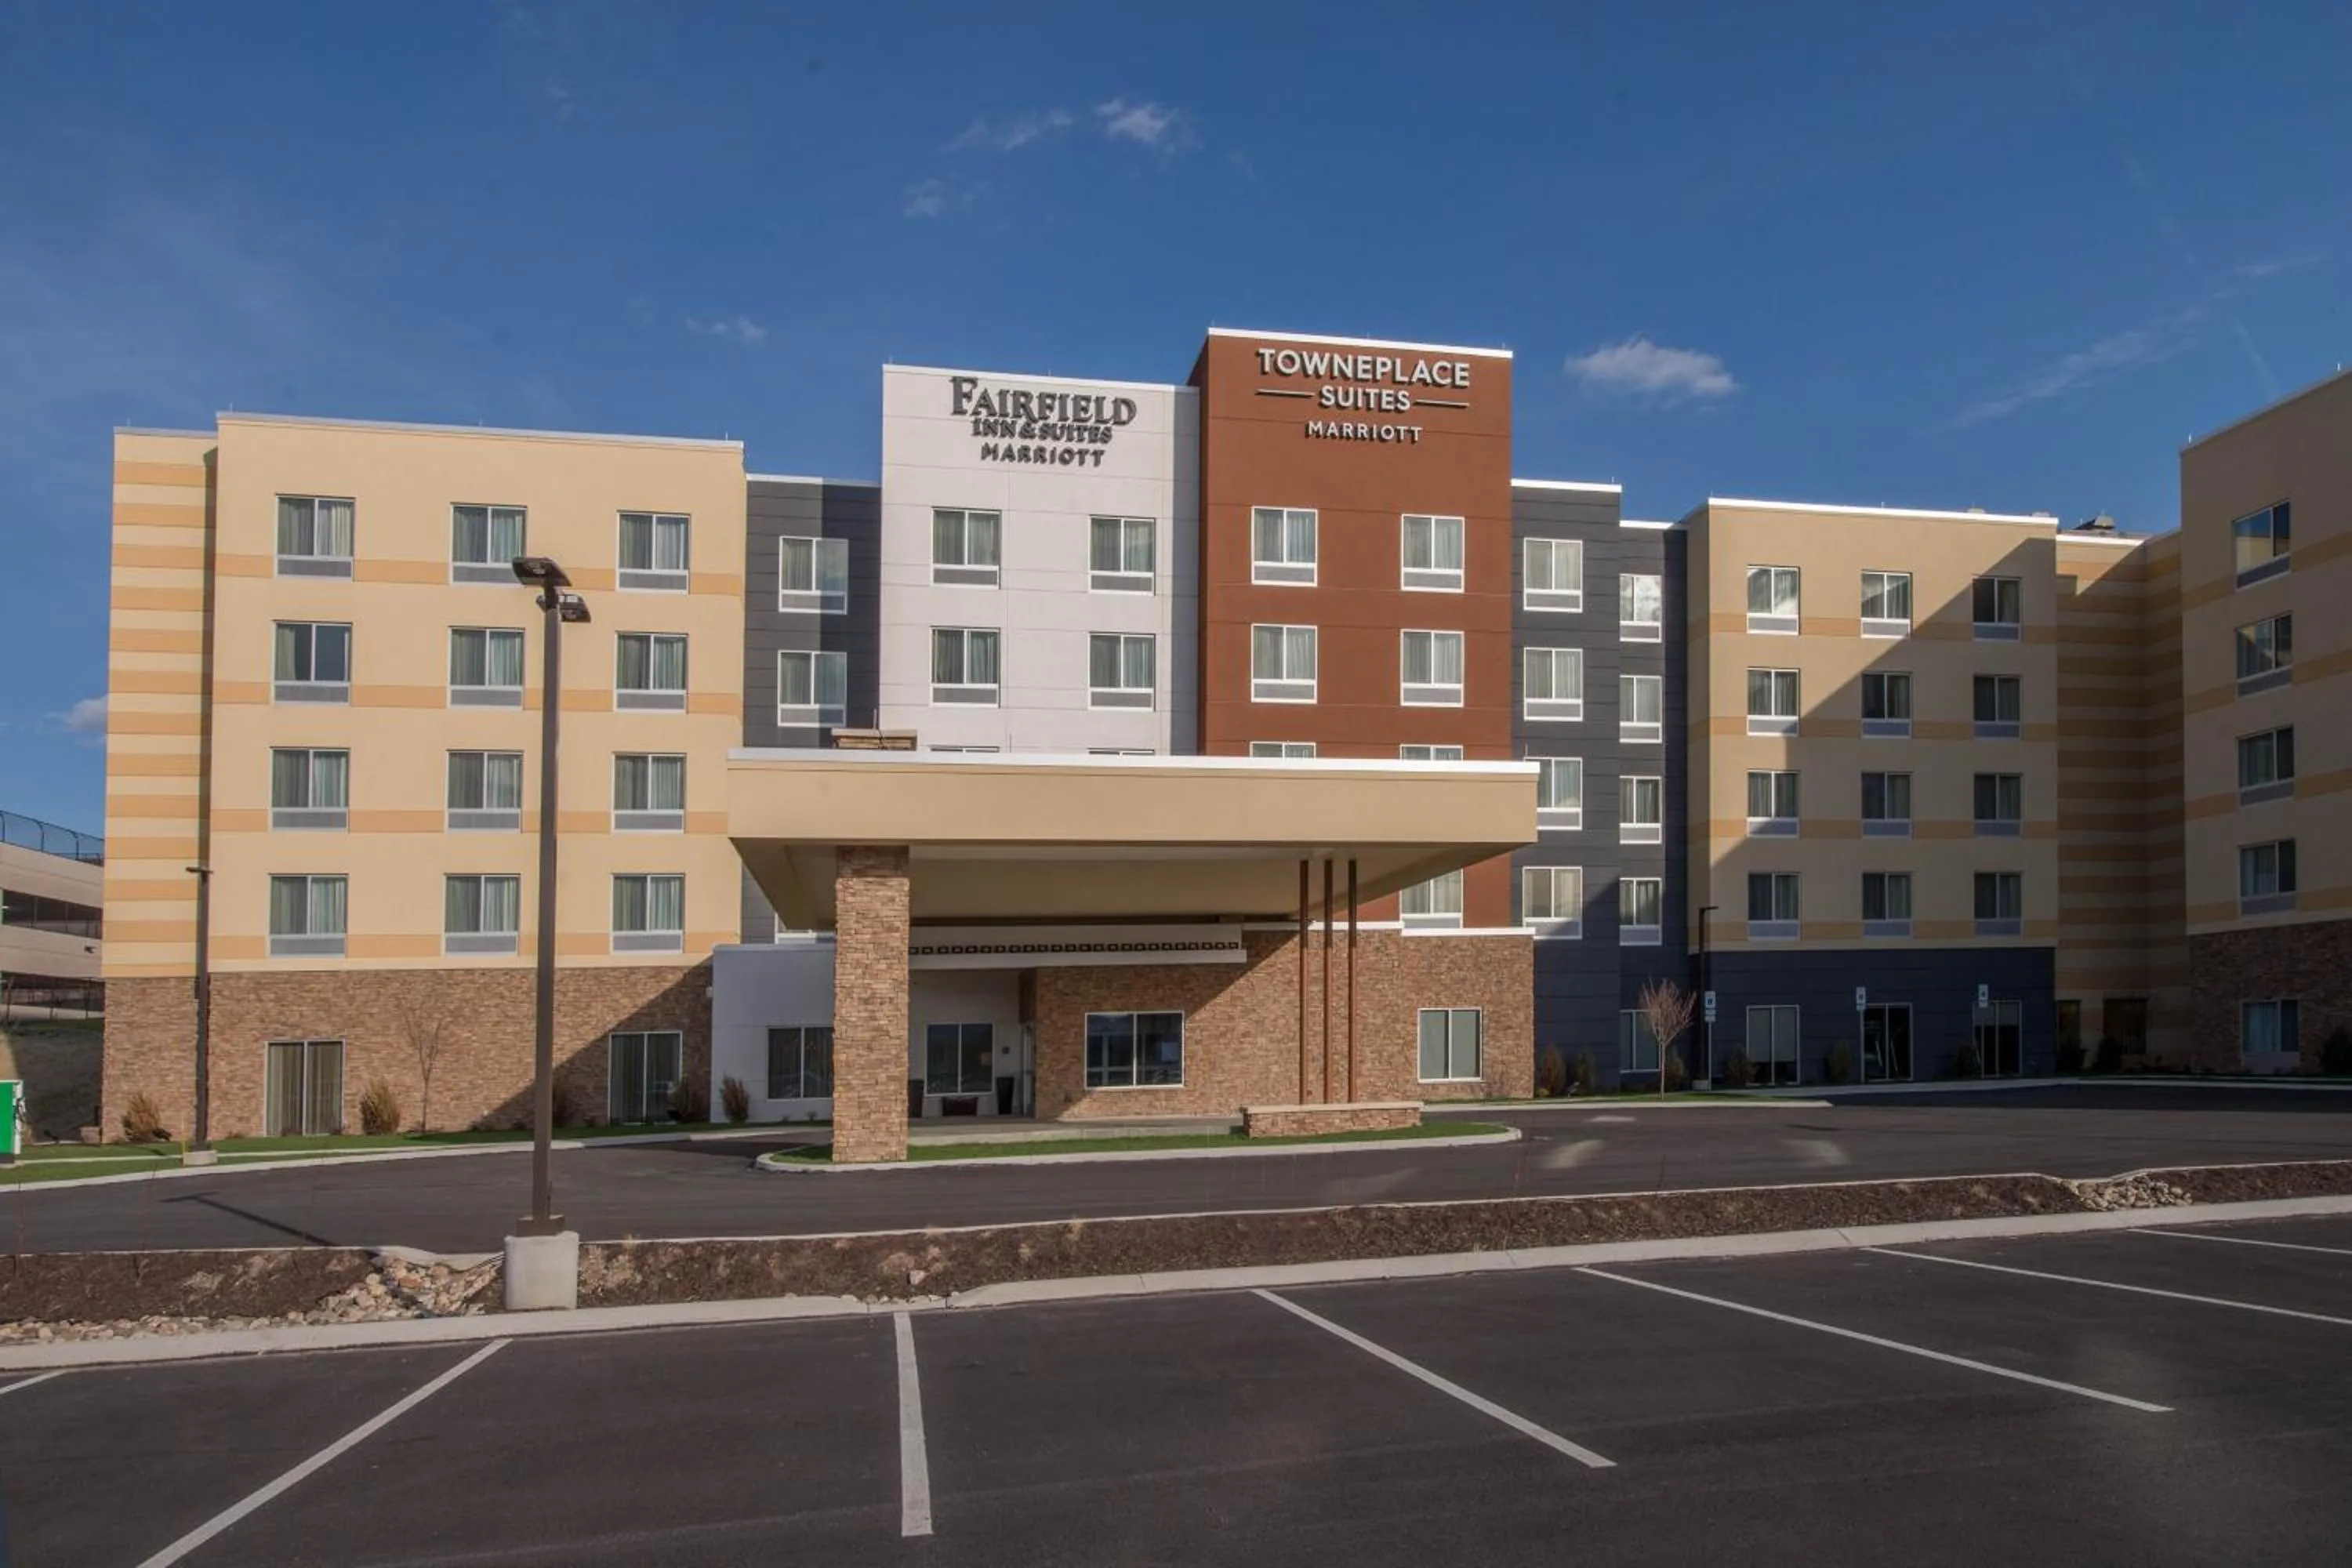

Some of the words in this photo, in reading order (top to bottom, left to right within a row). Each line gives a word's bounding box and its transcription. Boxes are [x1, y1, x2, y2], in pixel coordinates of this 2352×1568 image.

[1257, 348, 1471, 387] TOWNEPLACE
[949, 376, 1137, 426] FAIRFIELD
[1319, 385, 1411, 412] SUITES
[1305, 420, 1423, 443] MARRIOTT
[981, 442, 1105, 467] MARRIOTT
